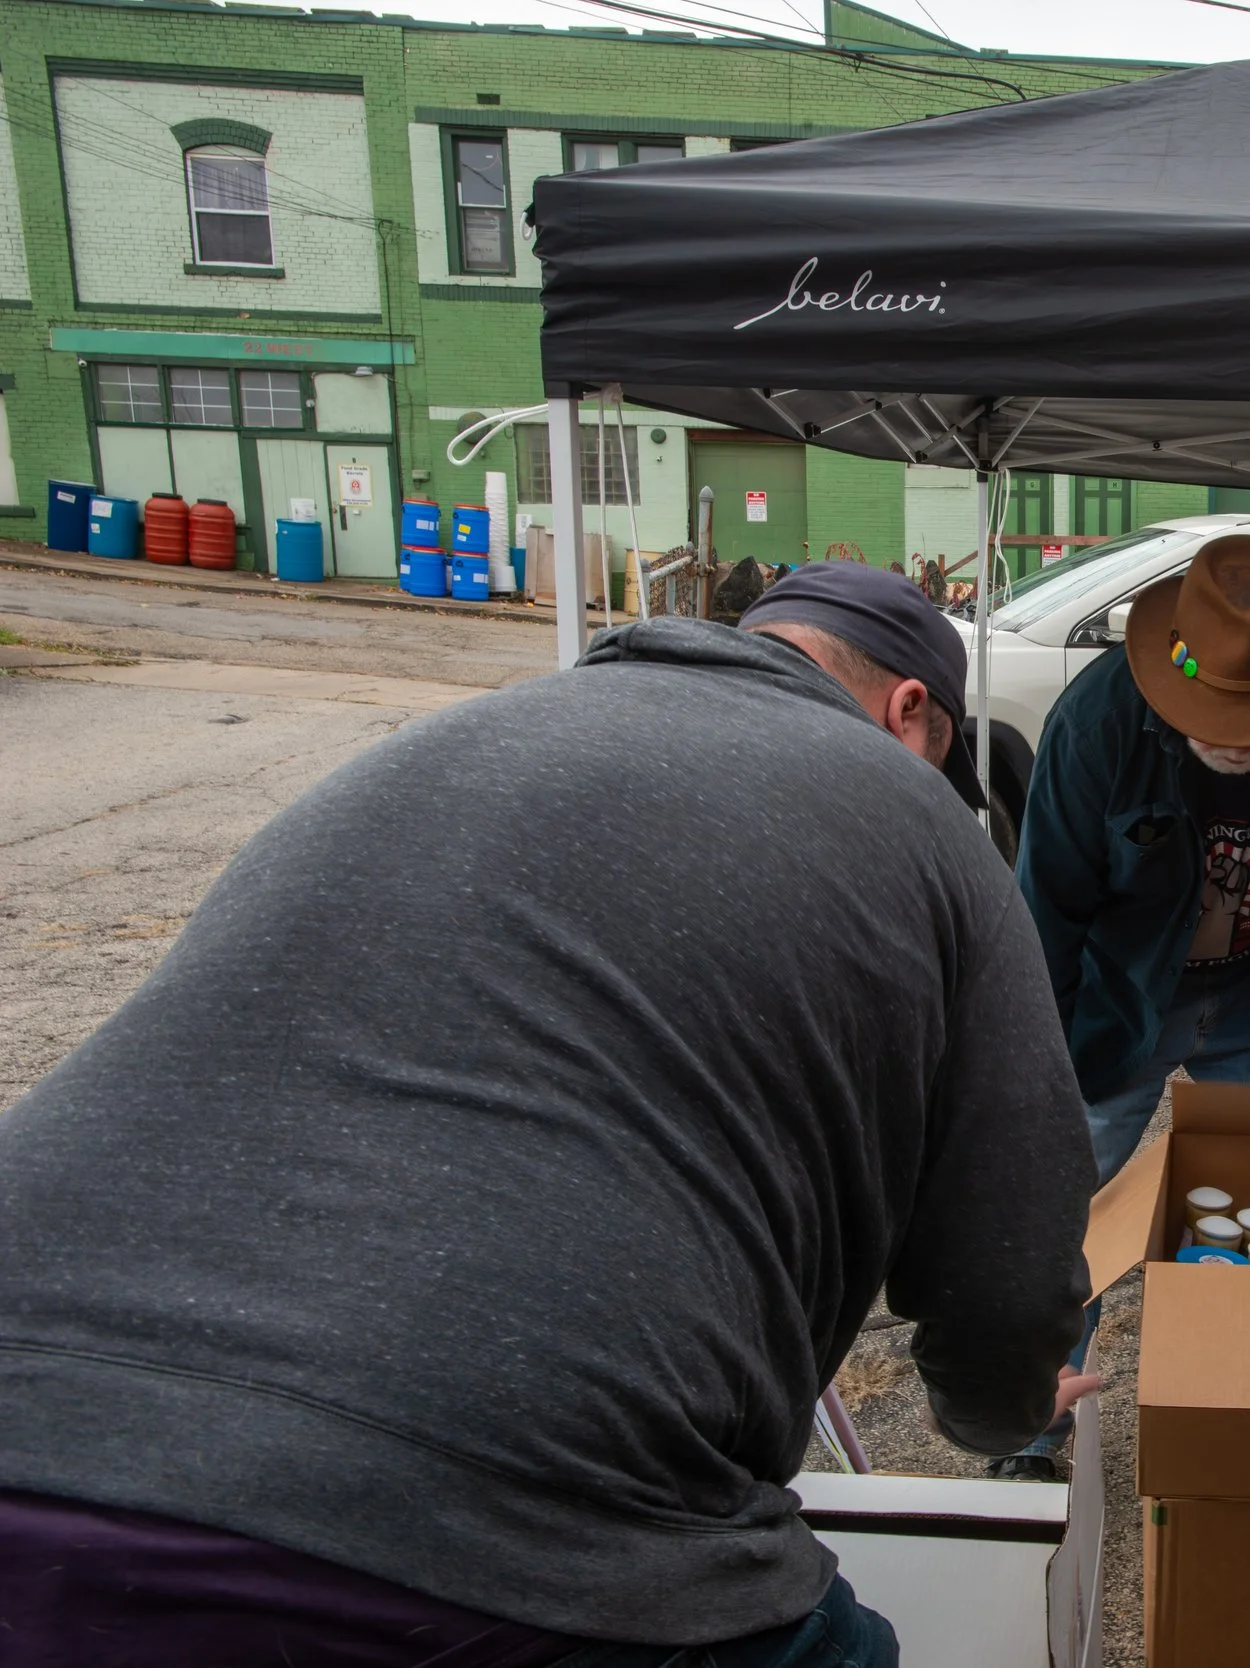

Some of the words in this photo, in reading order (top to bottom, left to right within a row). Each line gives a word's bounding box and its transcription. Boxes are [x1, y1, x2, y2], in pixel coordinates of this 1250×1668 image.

[733, 256, 947, 330] belavi
[243, 341, 262, 354] 22
[266, 342, 313, 356] WEST
